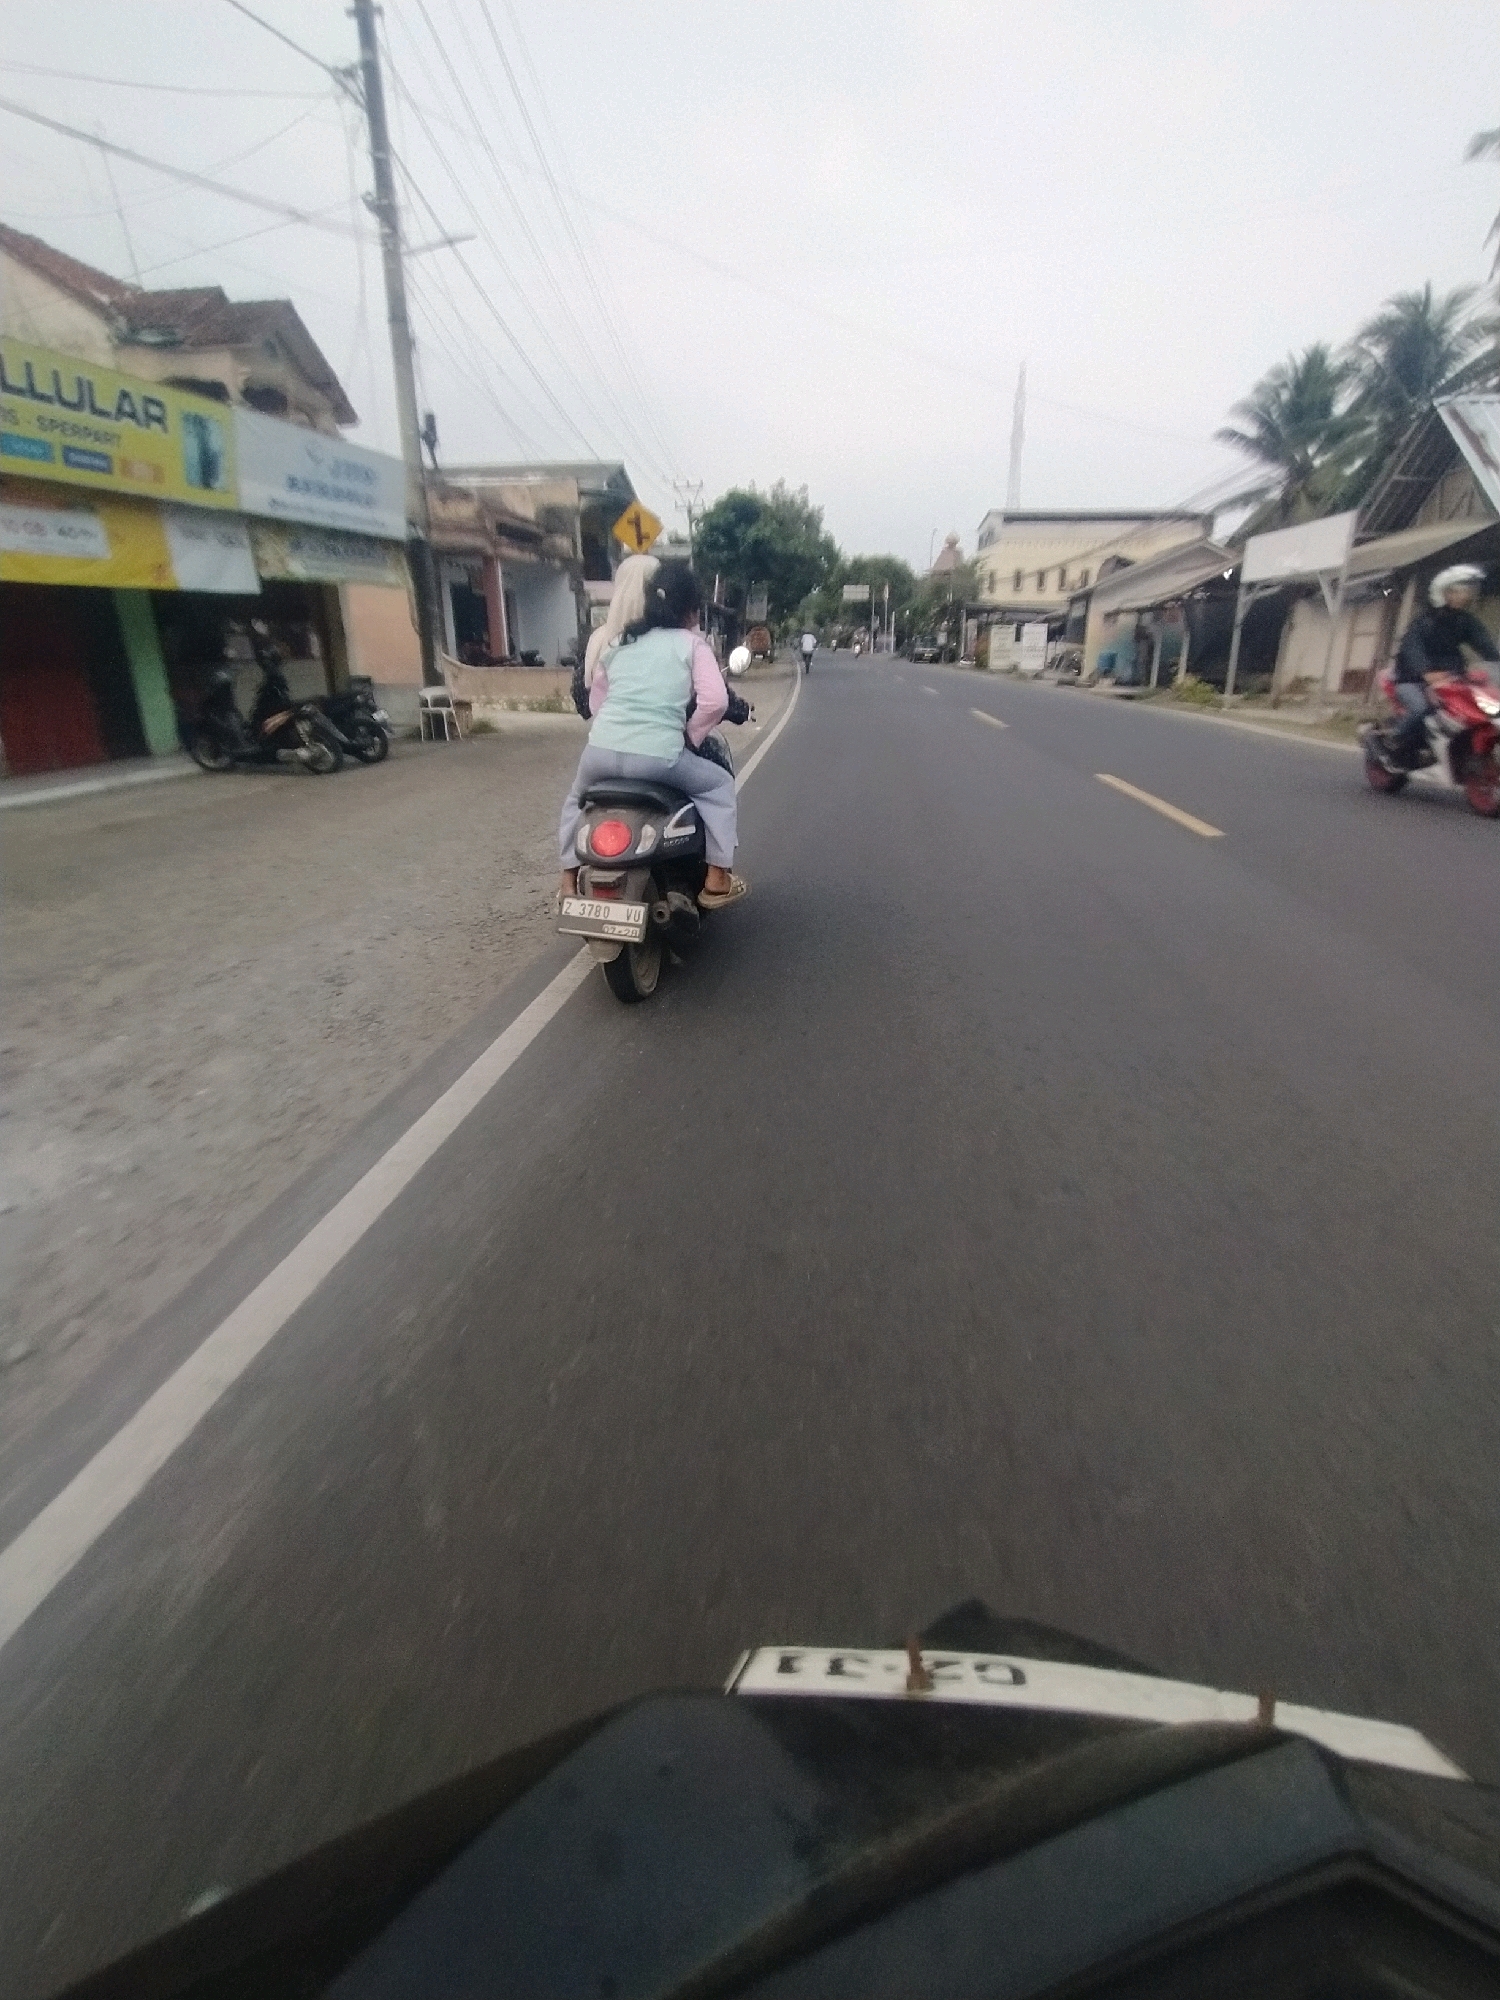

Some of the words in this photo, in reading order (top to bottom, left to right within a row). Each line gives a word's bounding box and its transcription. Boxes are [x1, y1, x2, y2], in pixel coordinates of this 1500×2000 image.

[564, 901, 573, 915] Z
[578, 903, 611, 919] 3780
[626, 907, 642, 923] VU
